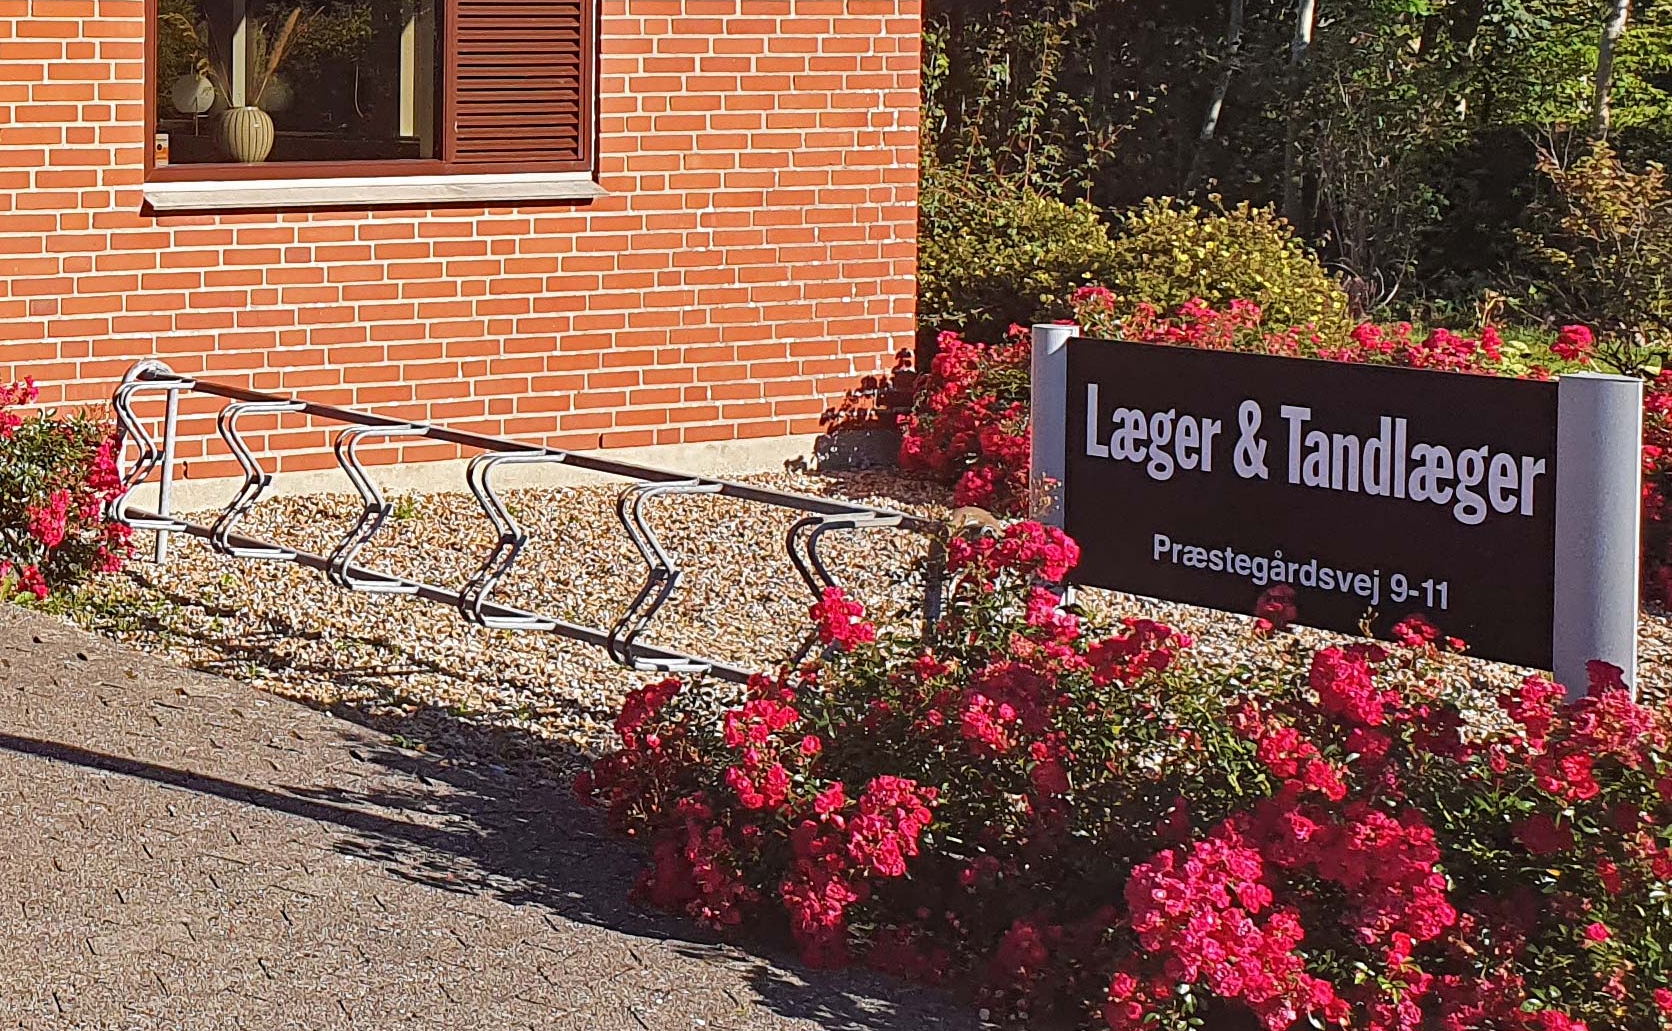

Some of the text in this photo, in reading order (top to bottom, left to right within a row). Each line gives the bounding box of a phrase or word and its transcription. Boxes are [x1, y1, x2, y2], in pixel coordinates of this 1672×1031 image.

[1086, 383, 1546, 525] Læger & Tandlæger
[1152, 532, 1449, 610] Præstegårdsvej 9-11
